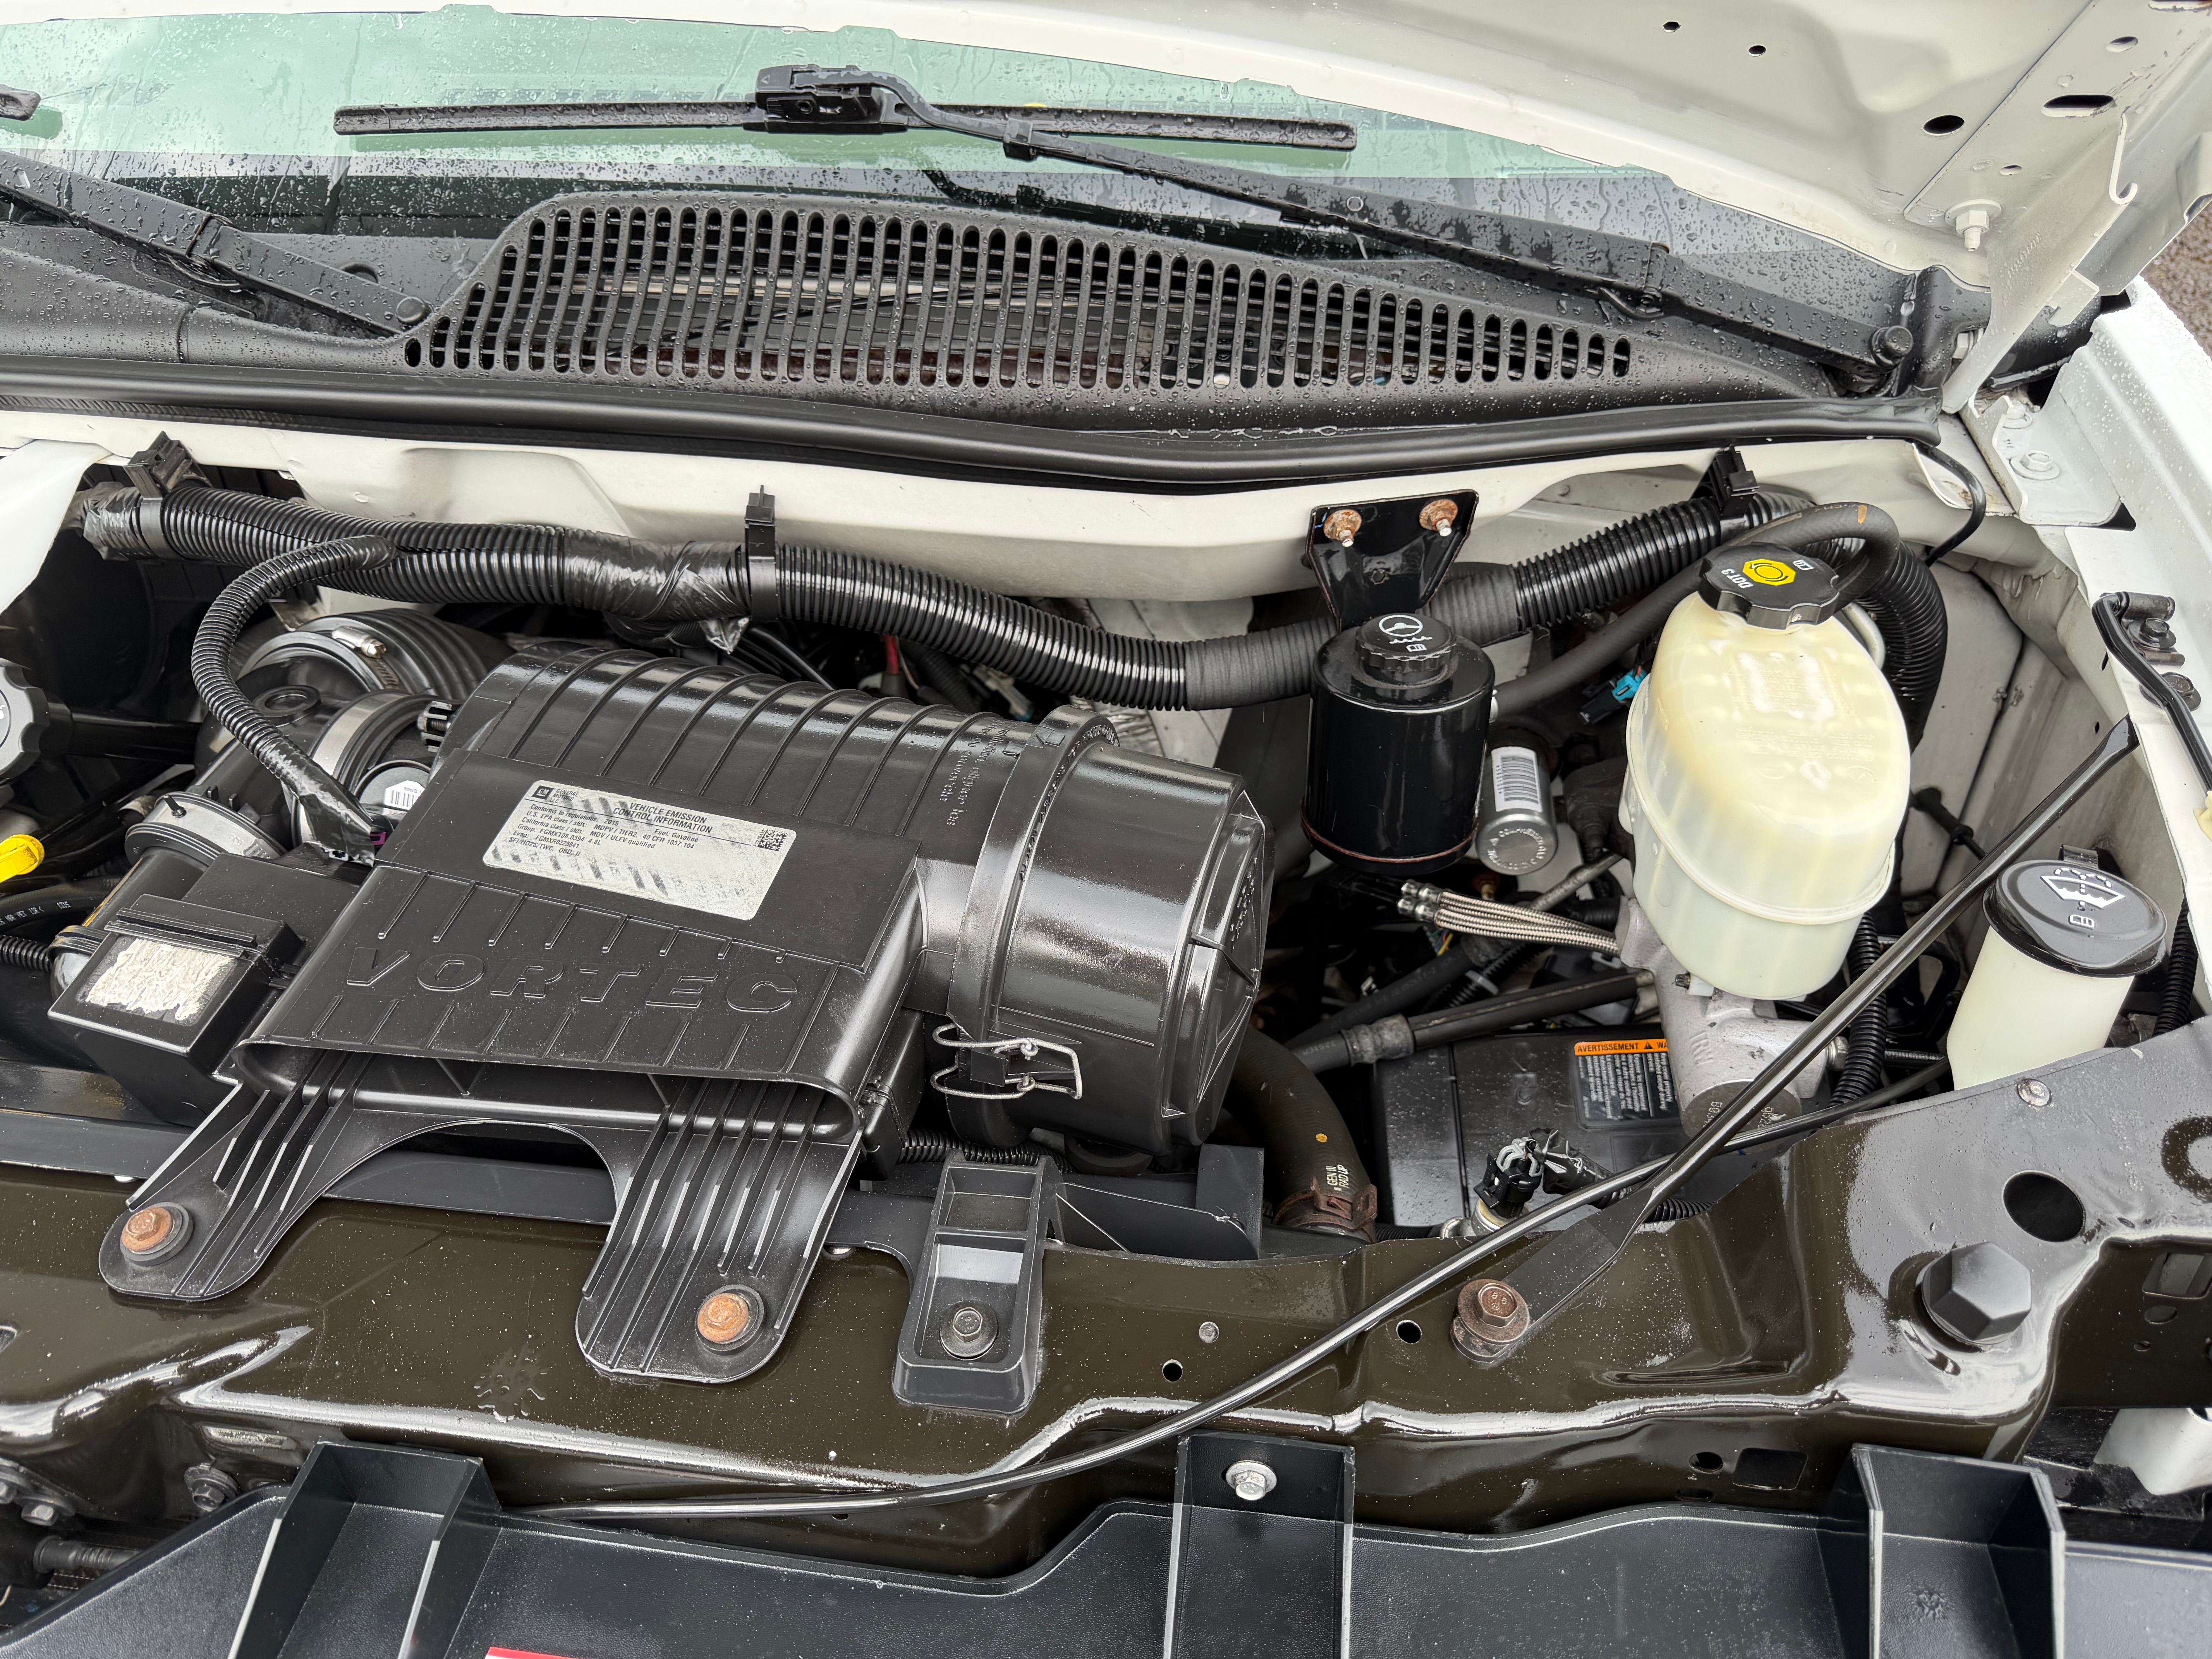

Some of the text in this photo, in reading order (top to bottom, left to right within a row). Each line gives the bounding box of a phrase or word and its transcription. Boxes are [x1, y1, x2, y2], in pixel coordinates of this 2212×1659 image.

[1726, 574, 1753, 589] DOT
[531, 804, 557, 814] Conforms
[565, 813, 599, 822] regulations:
[613, 807, 713, 833] CONTROL INFORMATION
[630, 802, 707, 823] VEHICLE EMISSION
[518, 824, 536, 833] Group:
[522, 817, 548, 827] California
[628, 839, 656, 848] qualified
[594, 824, 614, 833] MDPV
[620, 829, 638, 838] TIER2,
[667, 839, 695, 849] 1037.104
[654, 829, 699, 843] Fuel: Gasoline
[344, 946, 798, 1013] VORTEC
[1577, 1042, 1639, 1052] AVERTISSEMENT
[1327, 1171, 1338, 1186] GEN
[1337, 1164, 1350, 1188] RAD UP
